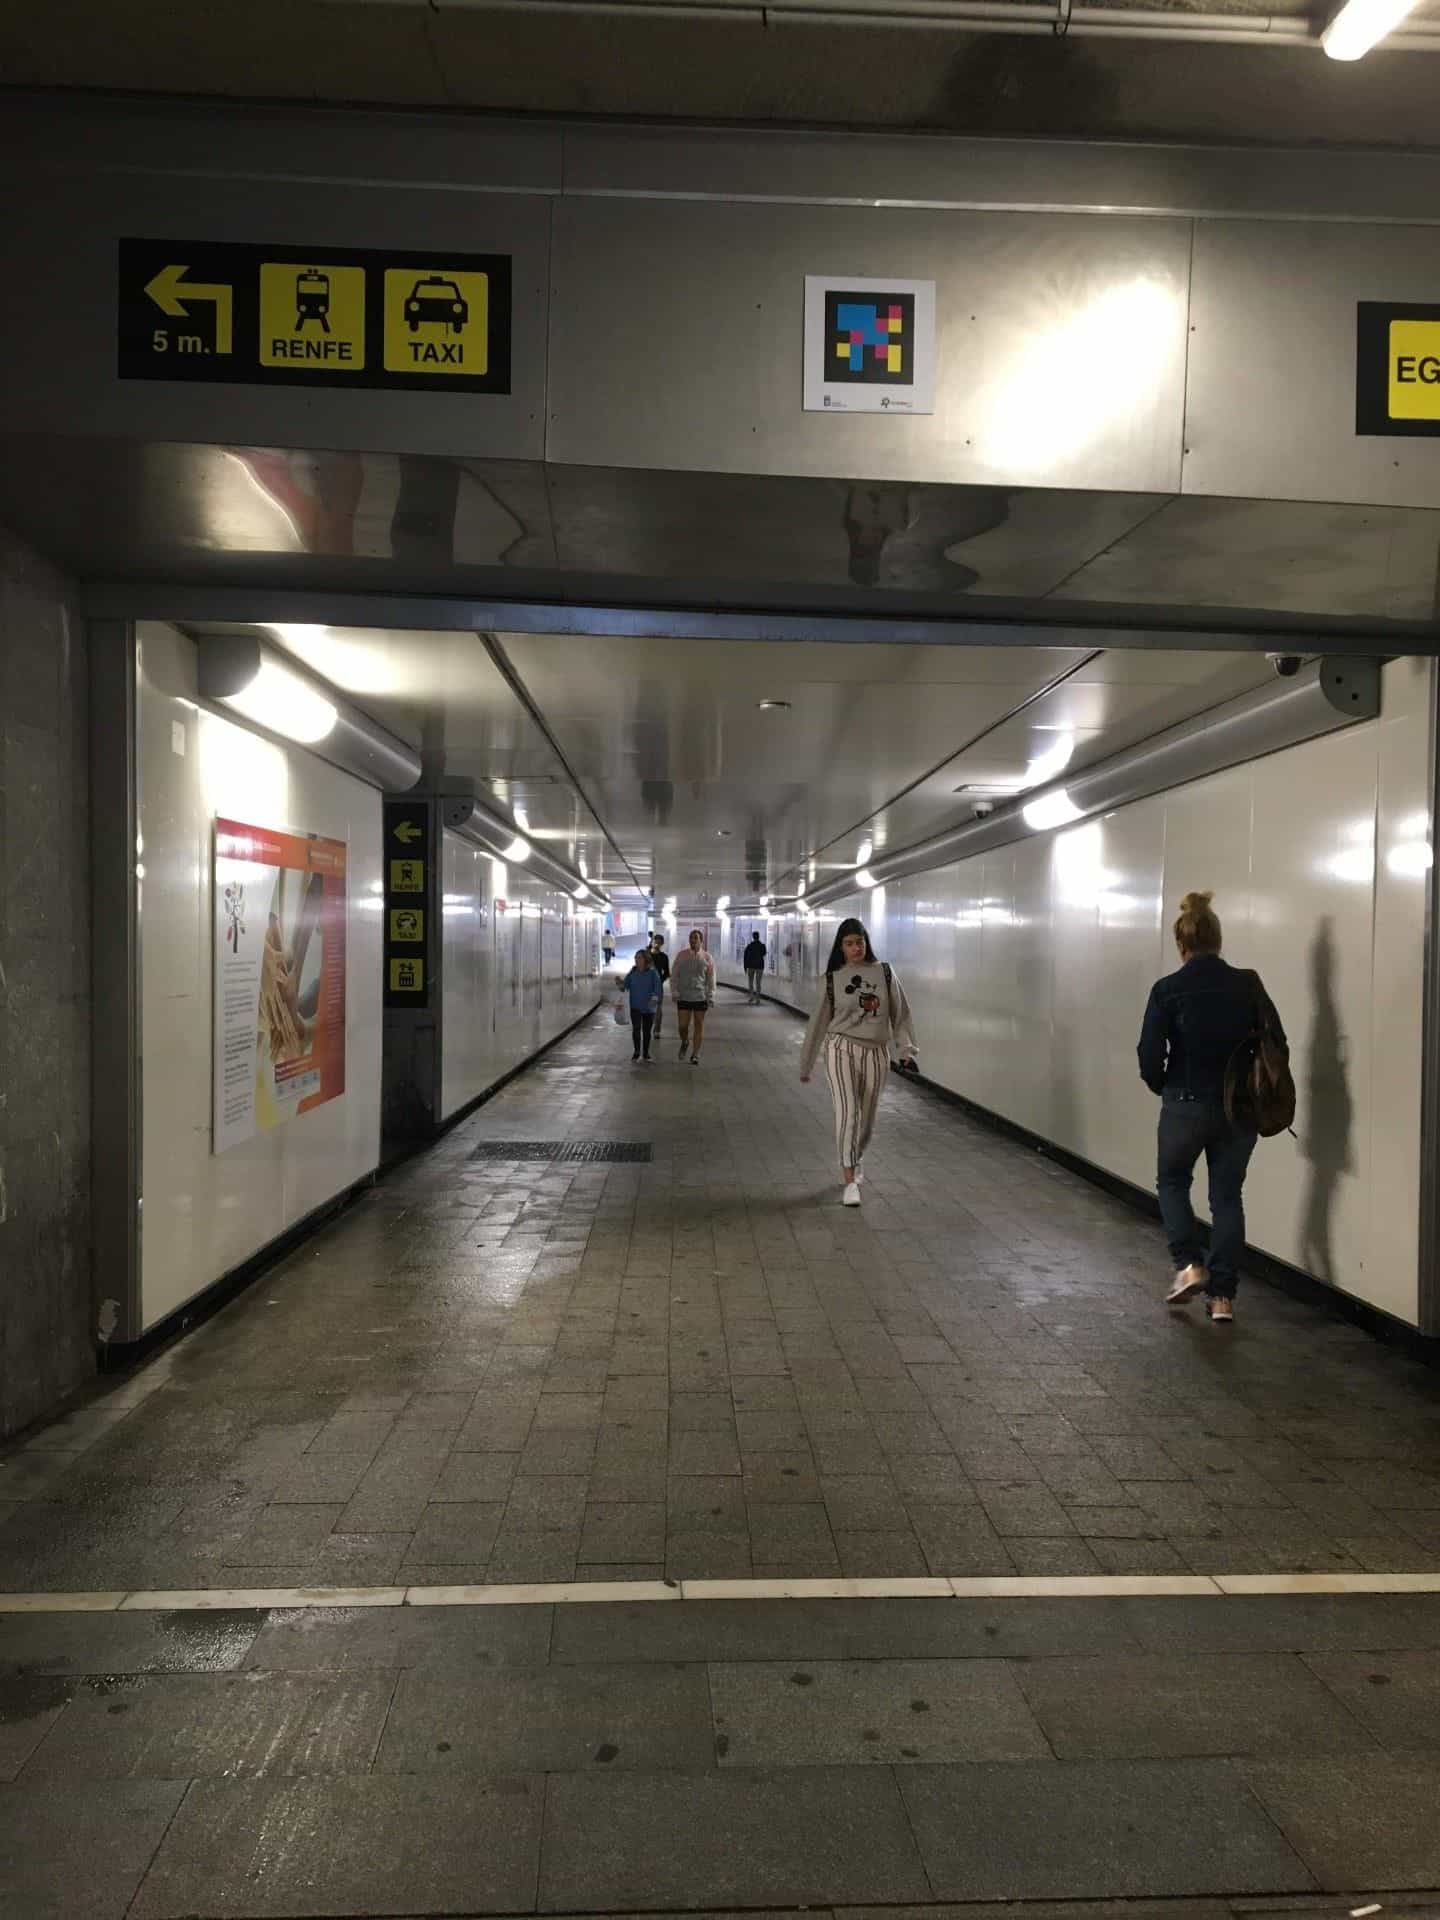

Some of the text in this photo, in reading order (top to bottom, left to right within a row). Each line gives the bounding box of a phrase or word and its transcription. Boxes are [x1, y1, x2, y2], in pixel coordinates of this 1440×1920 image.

[152, 330, 211, 354] 5 m.
[271, 339, 353, 361] RENFE
[408, 341, 464, 364] TAXI
